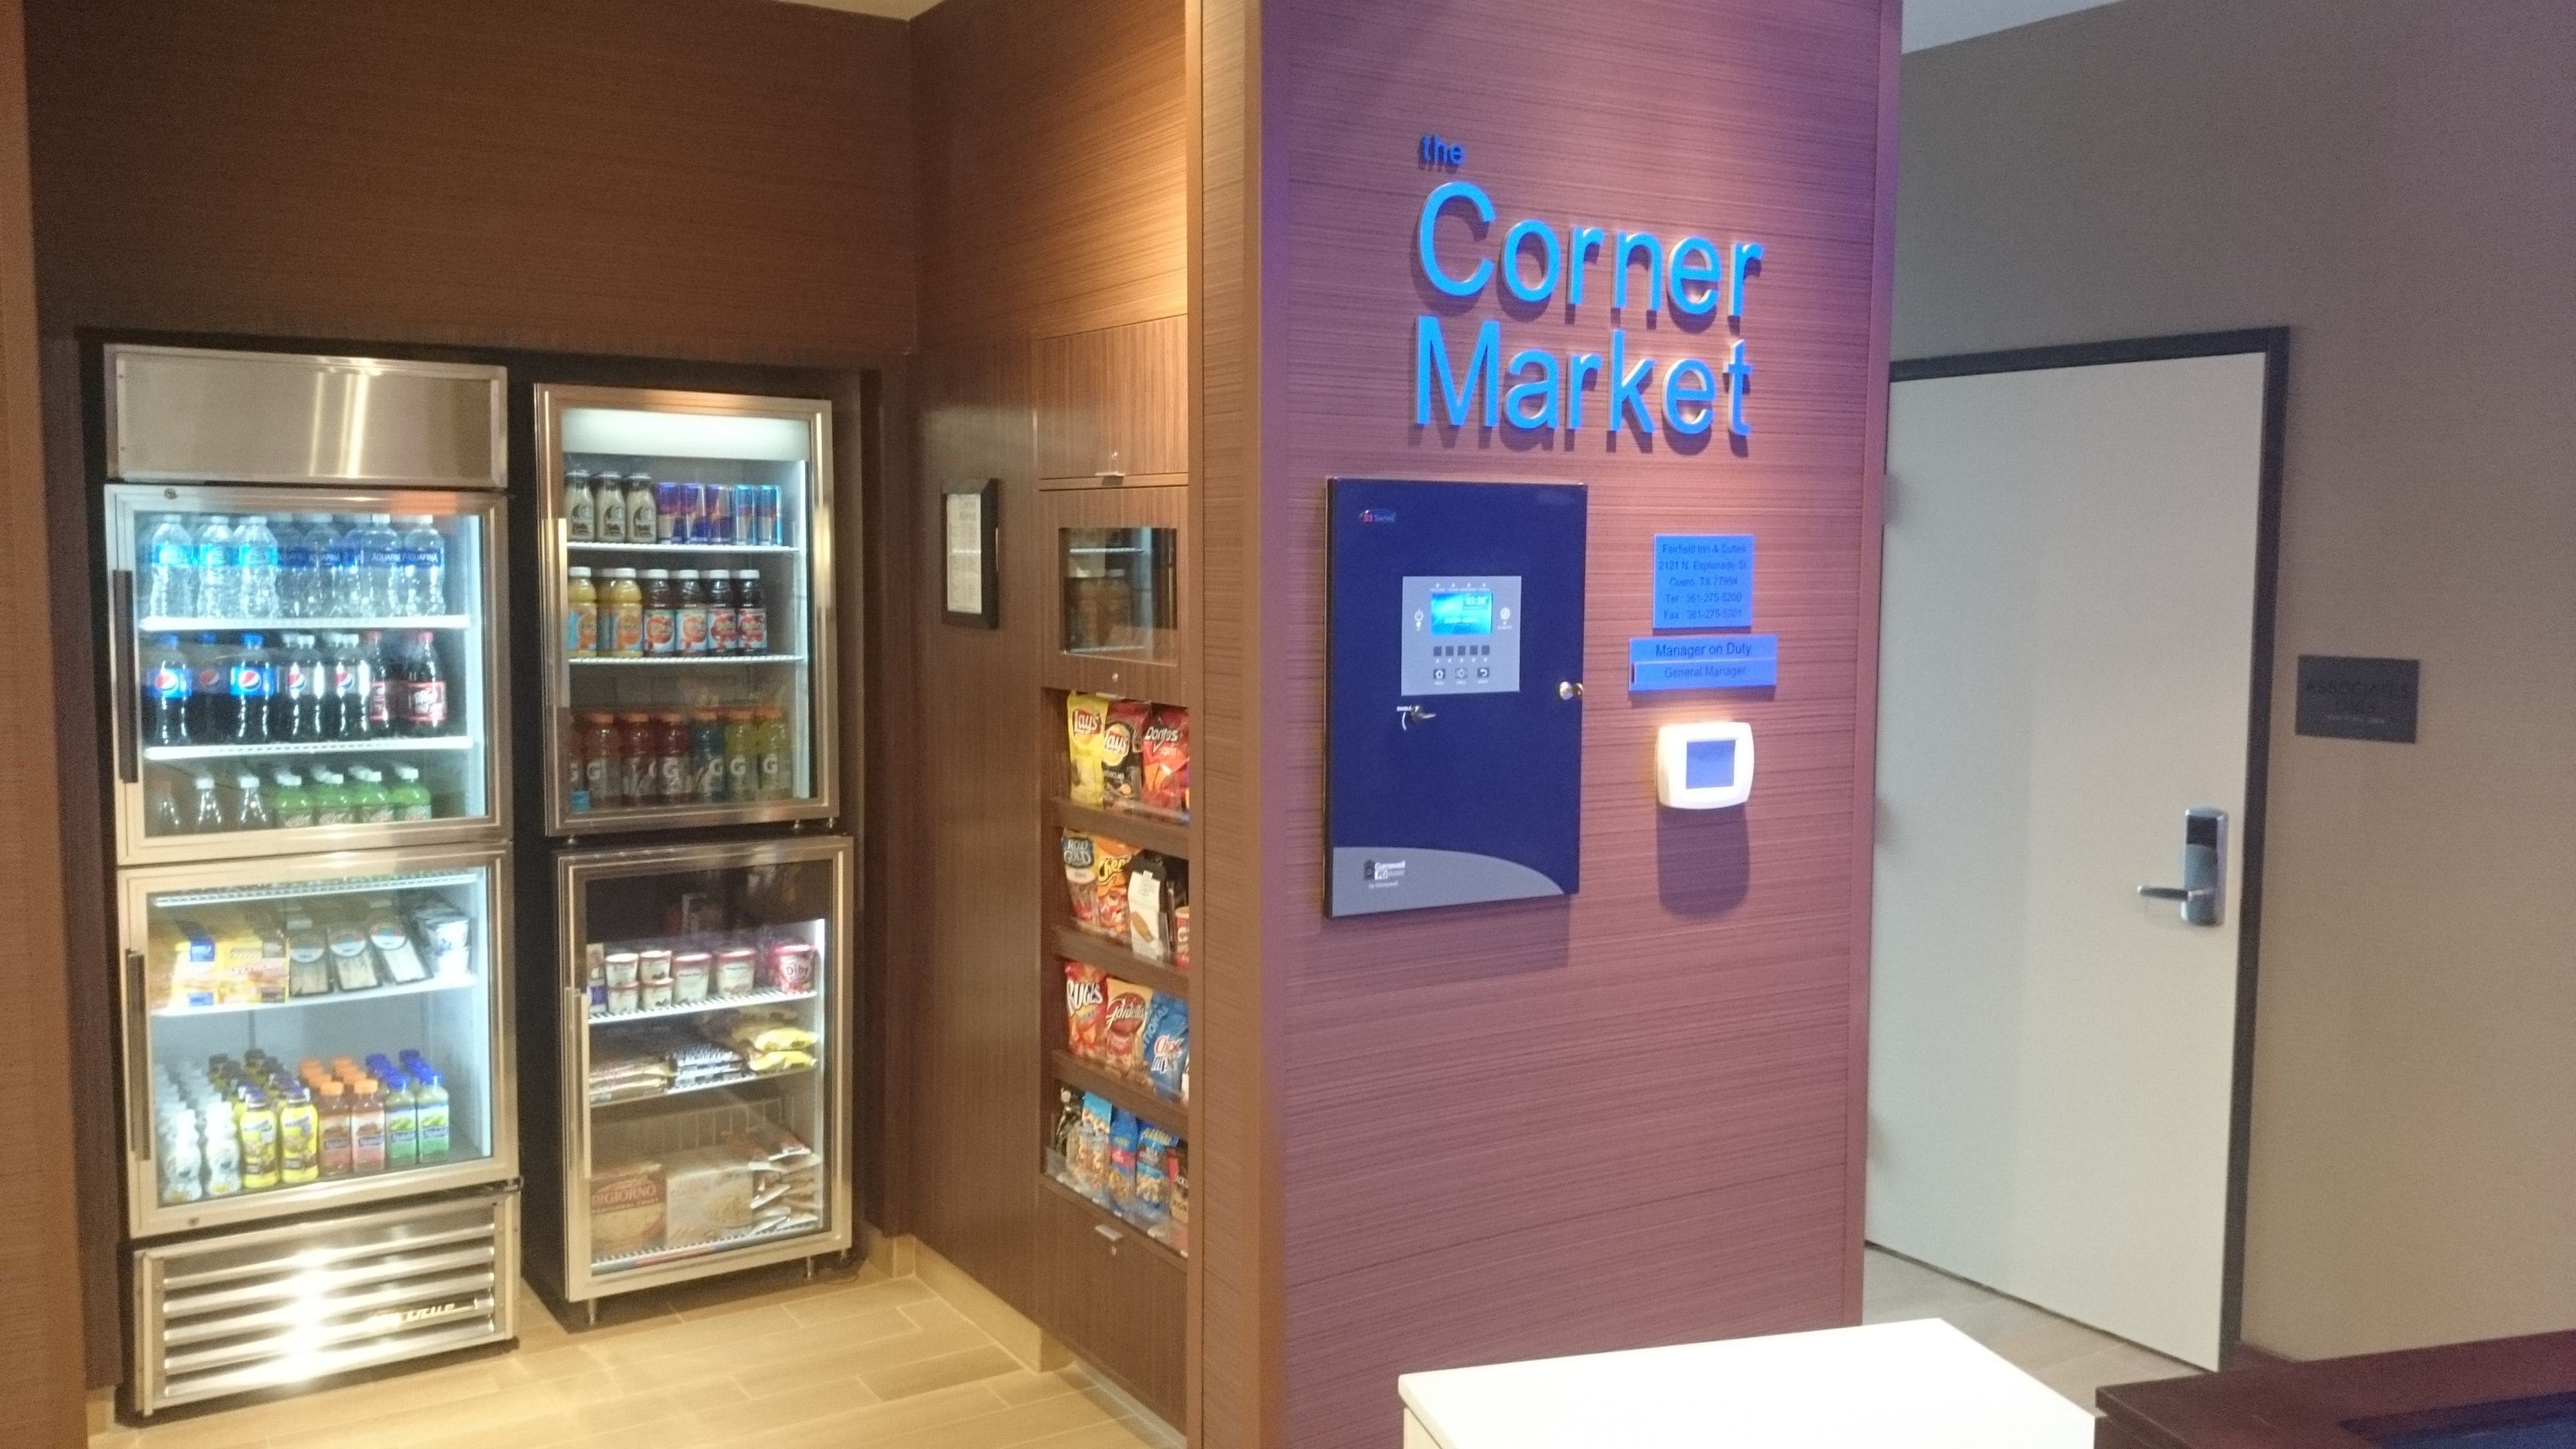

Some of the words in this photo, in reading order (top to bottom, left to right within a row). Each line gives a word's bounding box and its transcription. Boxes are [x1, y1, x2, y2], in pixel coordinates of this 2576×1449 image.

[1421, 134, 1465, 166] the
[1418, 180, 1763, 317] Corner
[1415, 315, 1752, 436] Market
[1662, 544, 1696, 554] Fairfield
[1721, 543, 1746, 553] Suites
[1658, 561, 1678, 571] 2121
[1693, 560, 1735, 572] Esplanade
[1700, 577, 1711, 587] TX
[1656, 643, 1707, 657] Manager
[1709, 644, 1723, 655] on
[1727, 642, 1752, 657] Duty
[1664, 665, 1704, 678] General
[1705, 665, 1747, 678] Manager
[1073, 709, 1102, 735] Lay's
[1104, 730, 1130, 757] Lay's
[1144, 726, 1179, 742] Doritos
[586, 761, 601, 780] G
[729, 756, 747, 776] G
[763, 754, 778, 774] G
[1154, 1034, 1185, 1058] Chex
